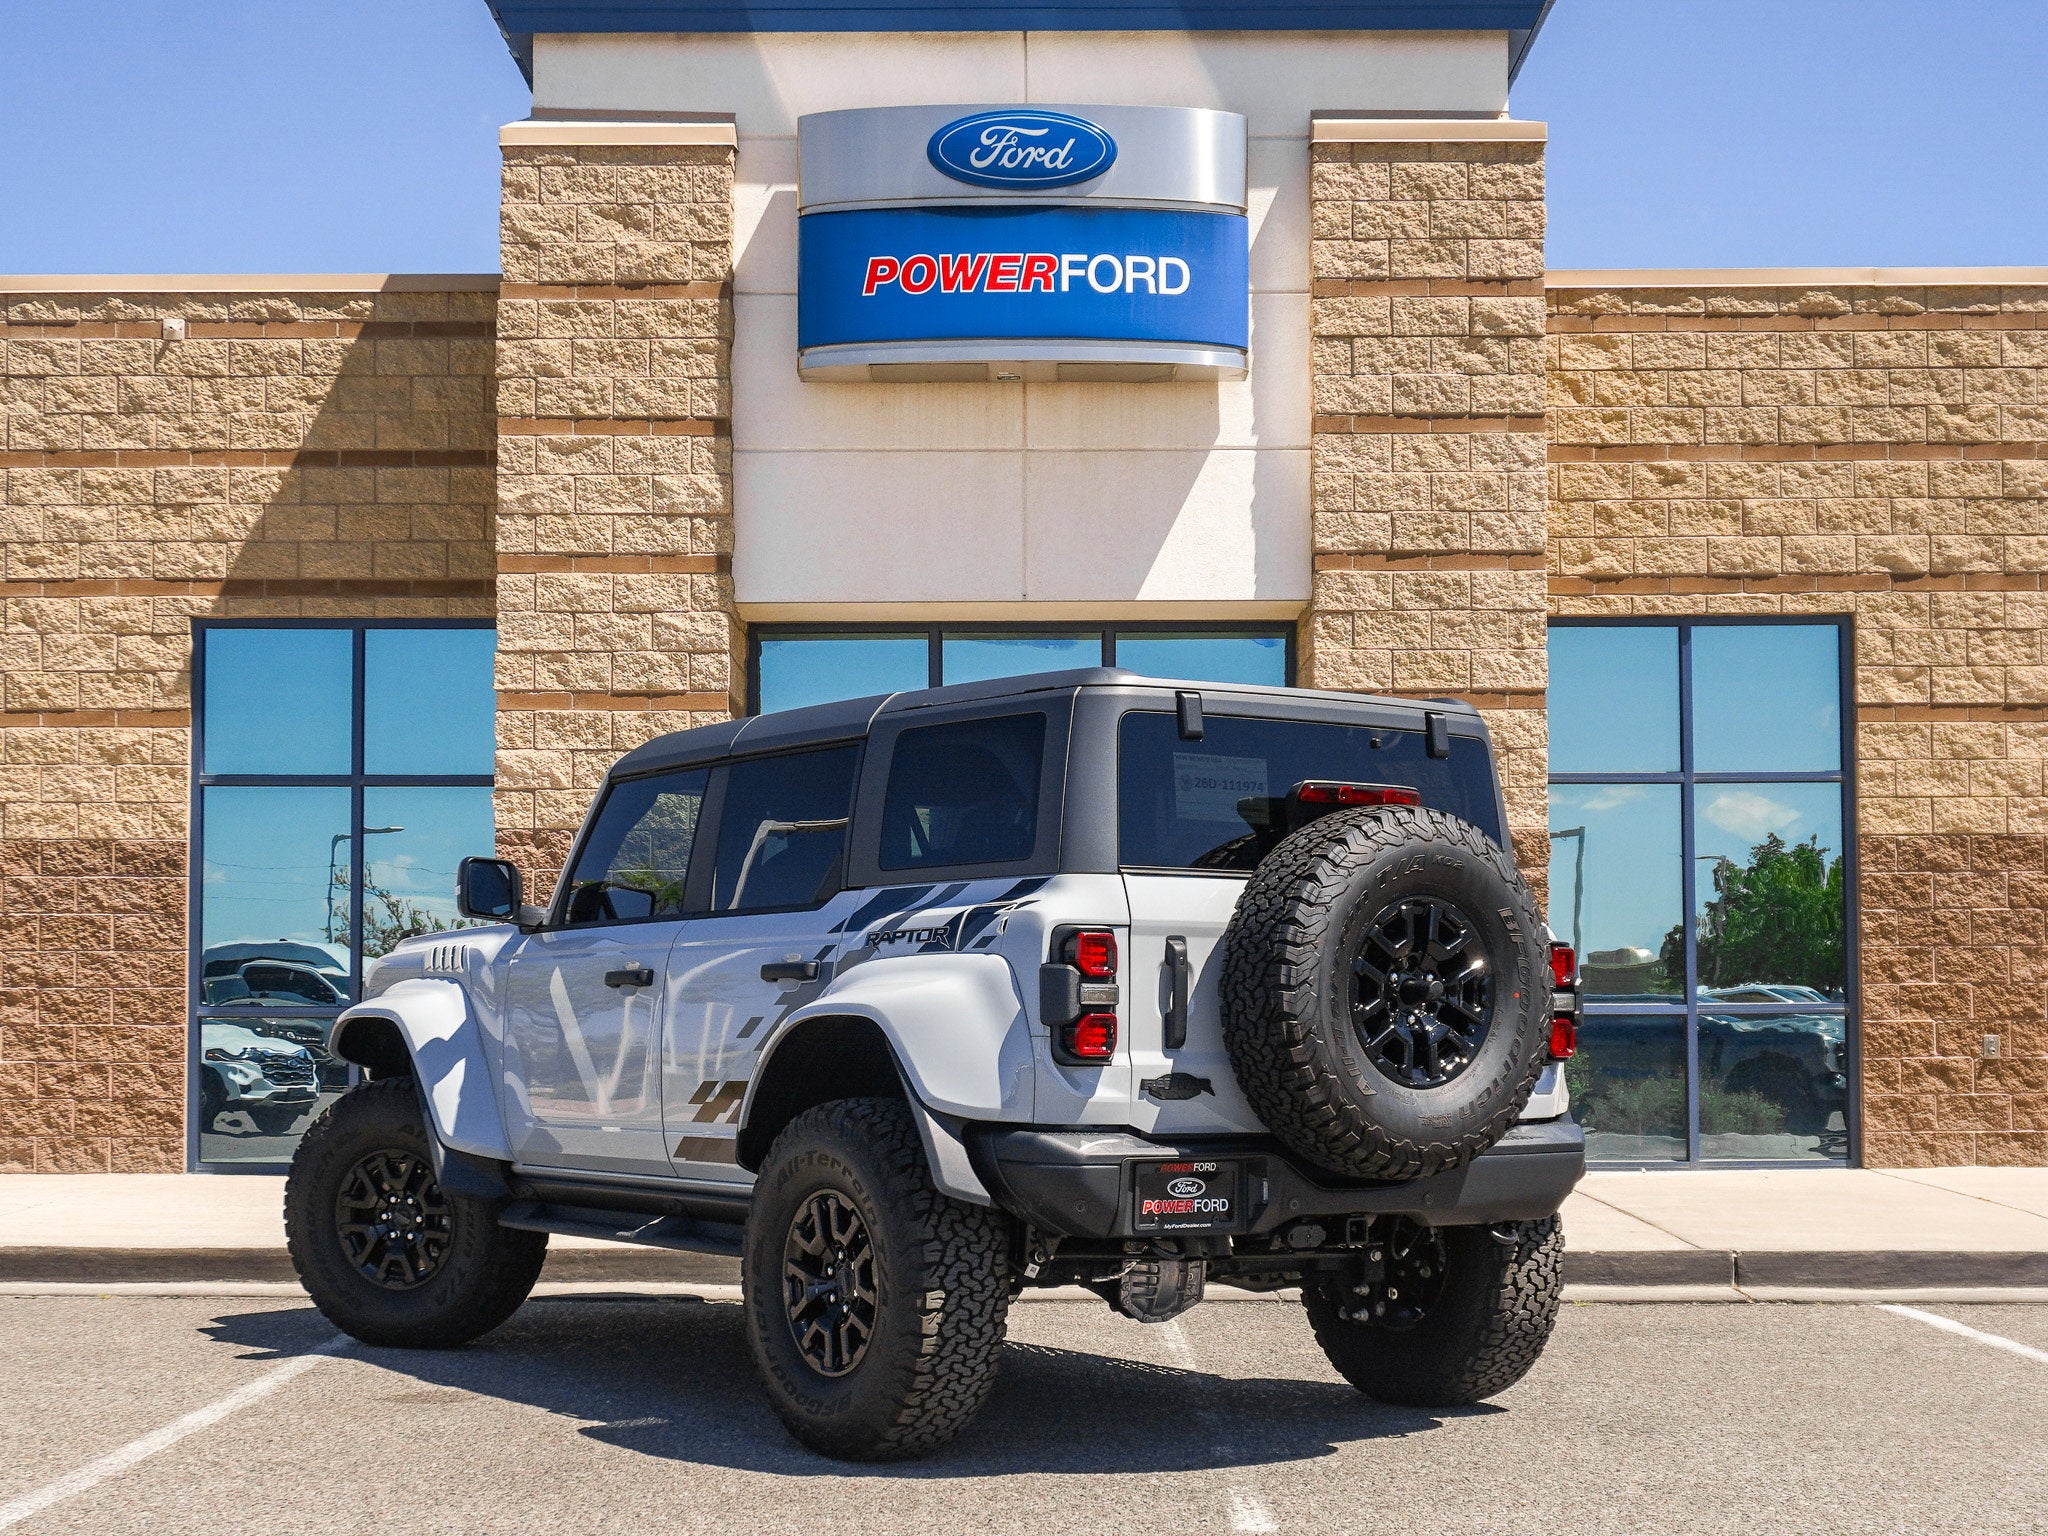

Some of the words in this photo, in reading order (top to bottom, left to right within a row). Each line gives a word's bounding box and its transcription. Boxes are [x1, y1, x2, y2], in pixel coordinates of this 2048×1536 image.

[970, 125, 1076, 170] Ford
[862, 253, 1192, 297] POWERFORD
[865, 925, 951, 953] RAPTOR
[1159, 1162, 1218, 1174] POWERFORD
[1175, 1181, 1198, 1193] Ford
[1141, 1198, 1230, 1215] POWERFORD
